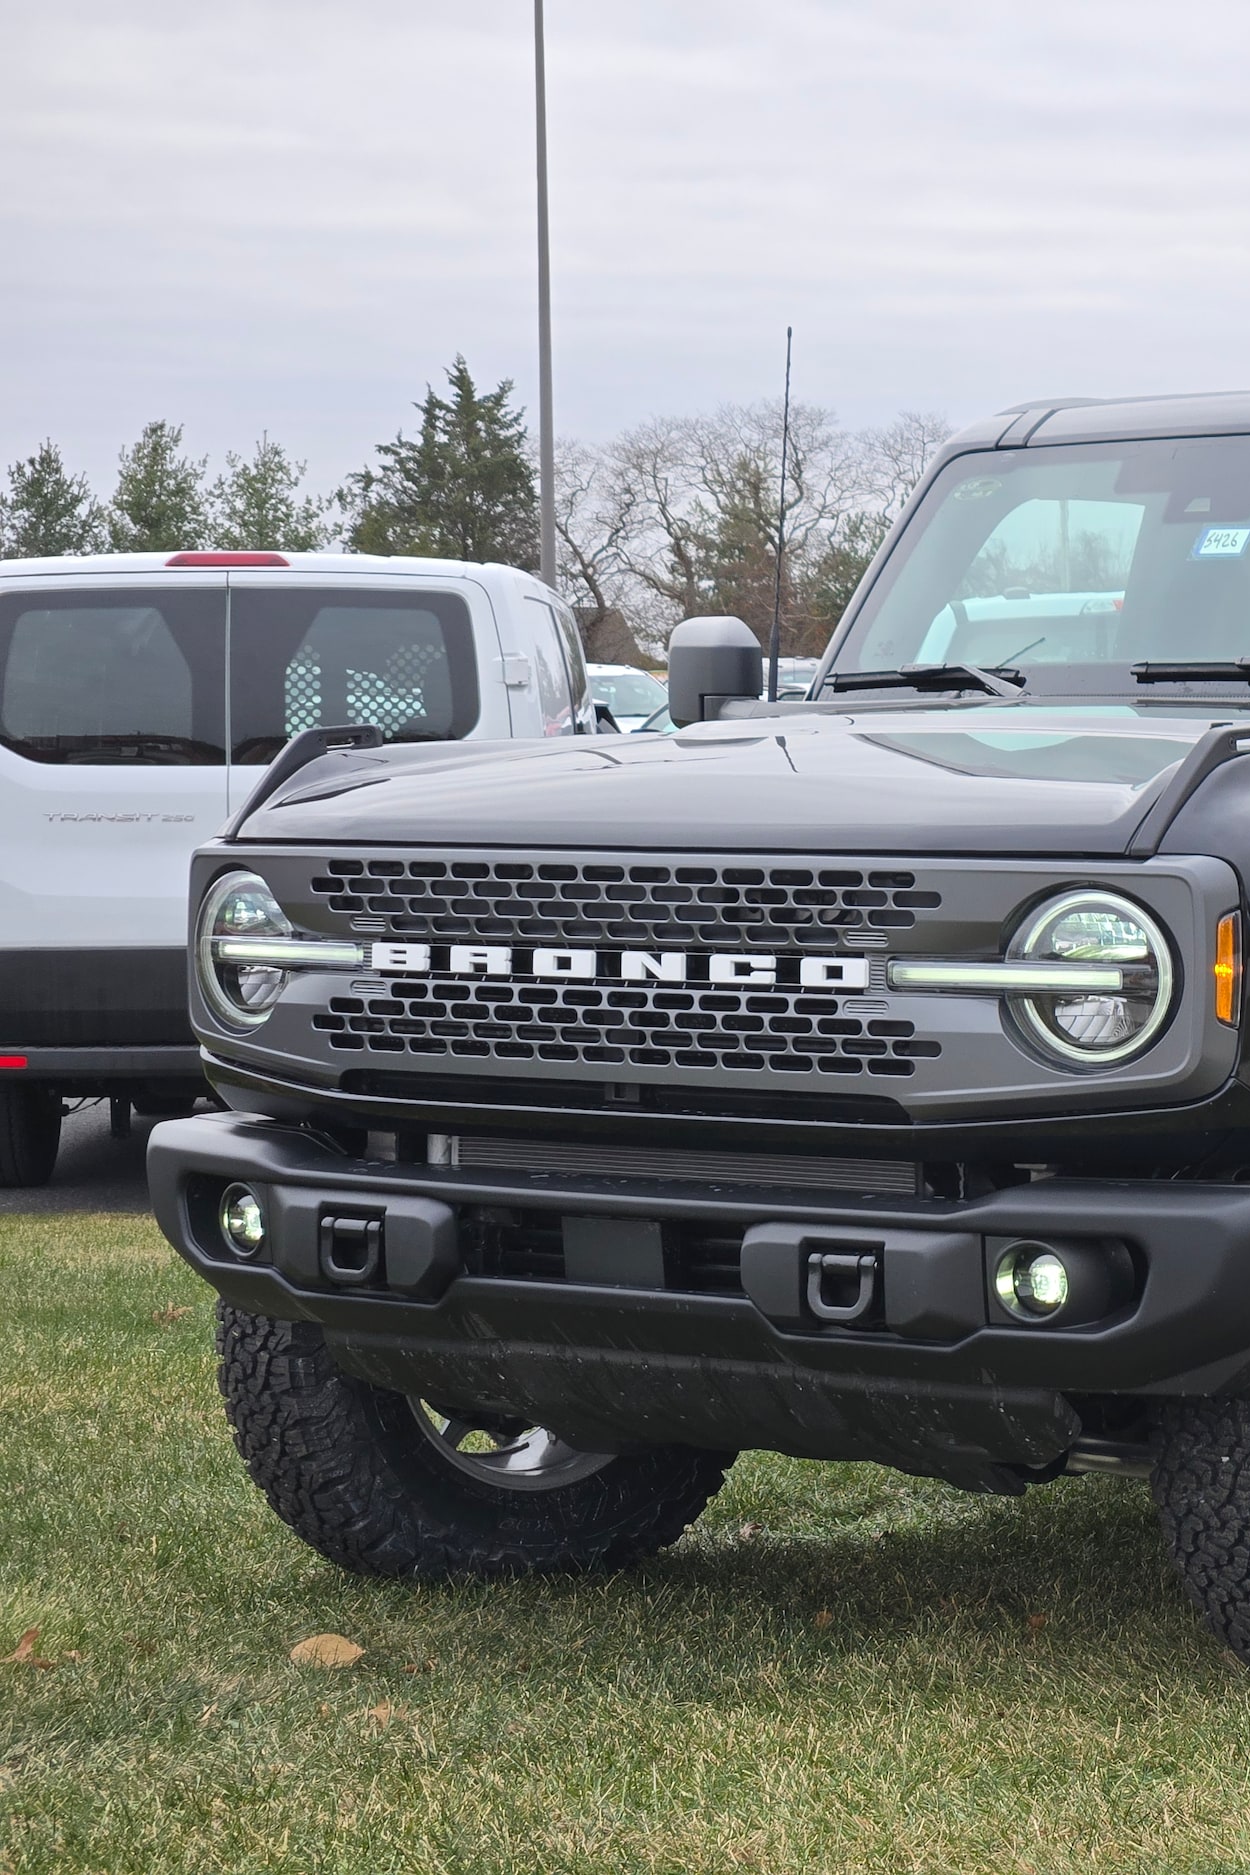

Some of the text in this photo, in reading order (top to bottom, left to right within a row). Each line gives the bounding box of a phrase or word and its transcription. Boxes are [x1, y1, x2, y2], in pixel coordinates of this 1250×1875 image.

[1203, 531, 1240, 549] 5426
[42, 811, 195, 823] TRANSIT 250
[371, 942, 870, 989] BRONCO
